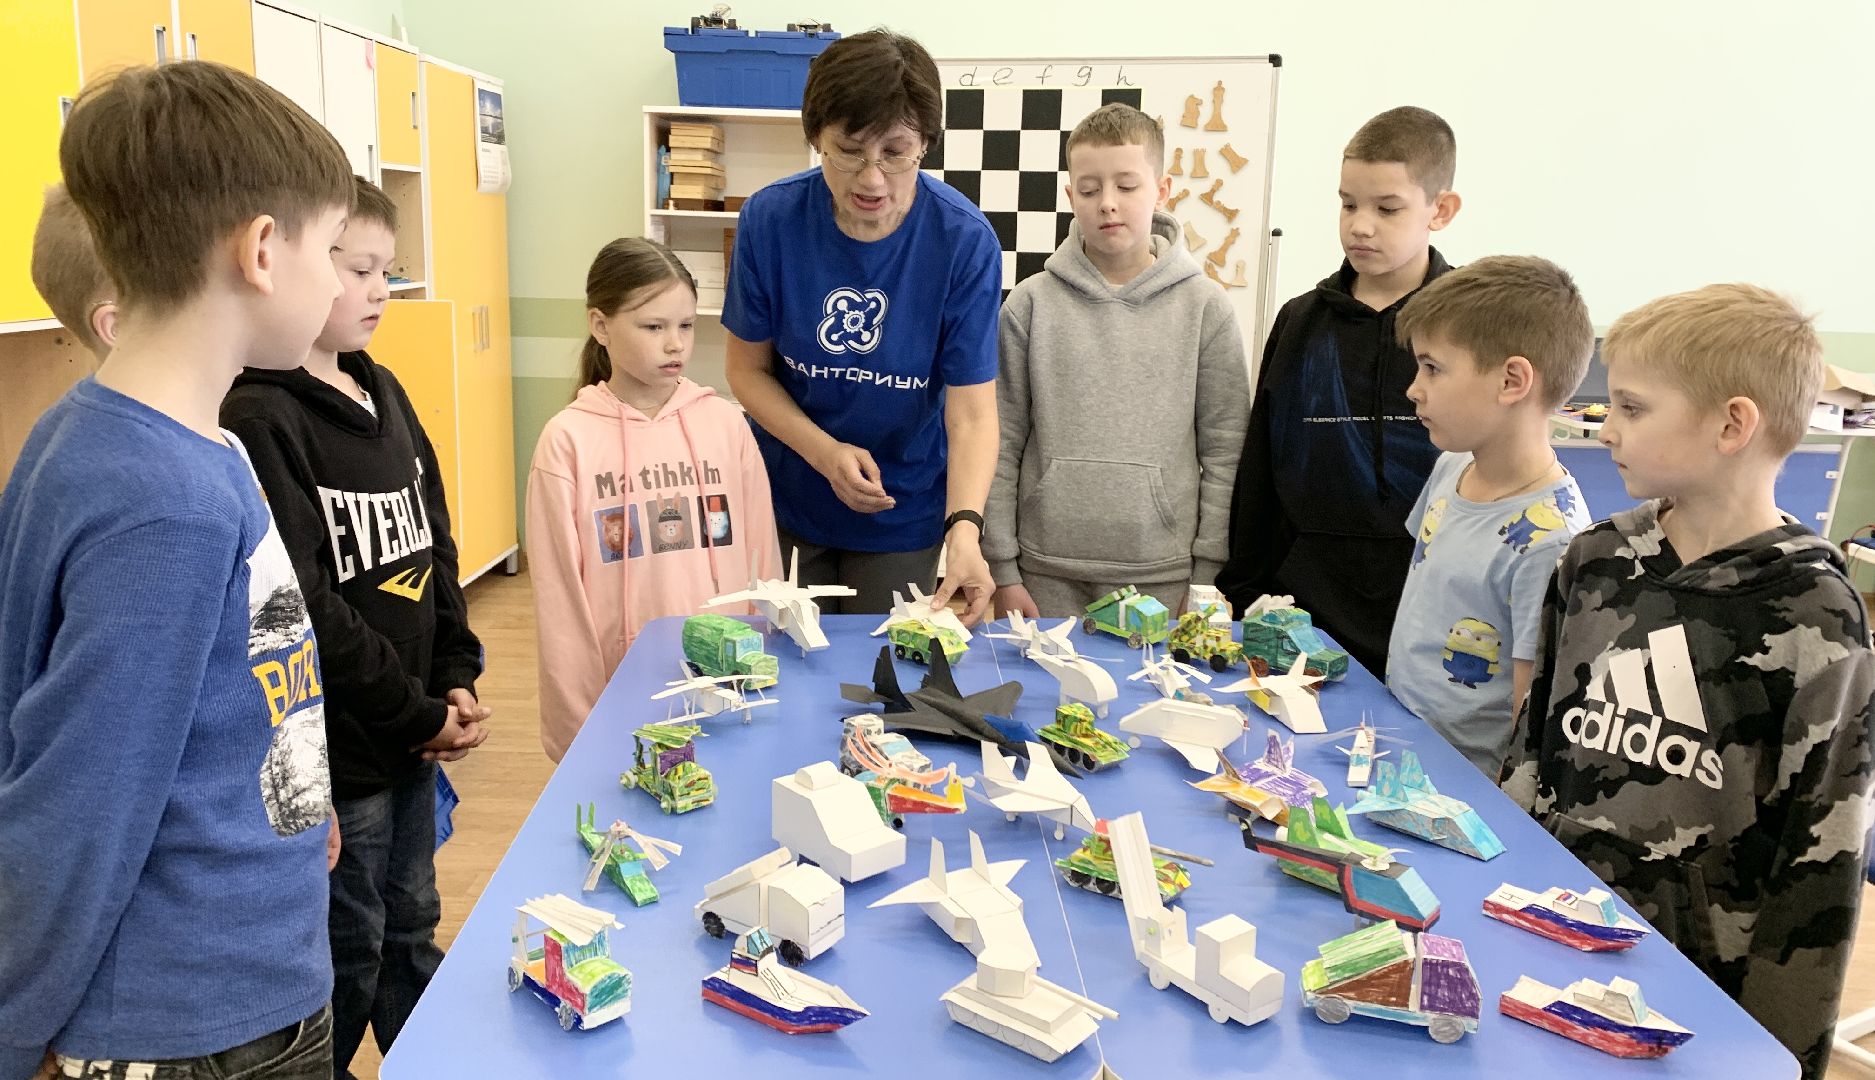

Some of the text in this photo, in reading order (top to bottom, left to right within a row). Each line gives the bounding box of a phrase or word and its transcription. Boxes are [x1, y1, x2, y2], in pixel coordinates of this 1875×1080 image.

[959, 64, 1135, 86] d e f g h
[1562, 701, 1724, 789] adidas
